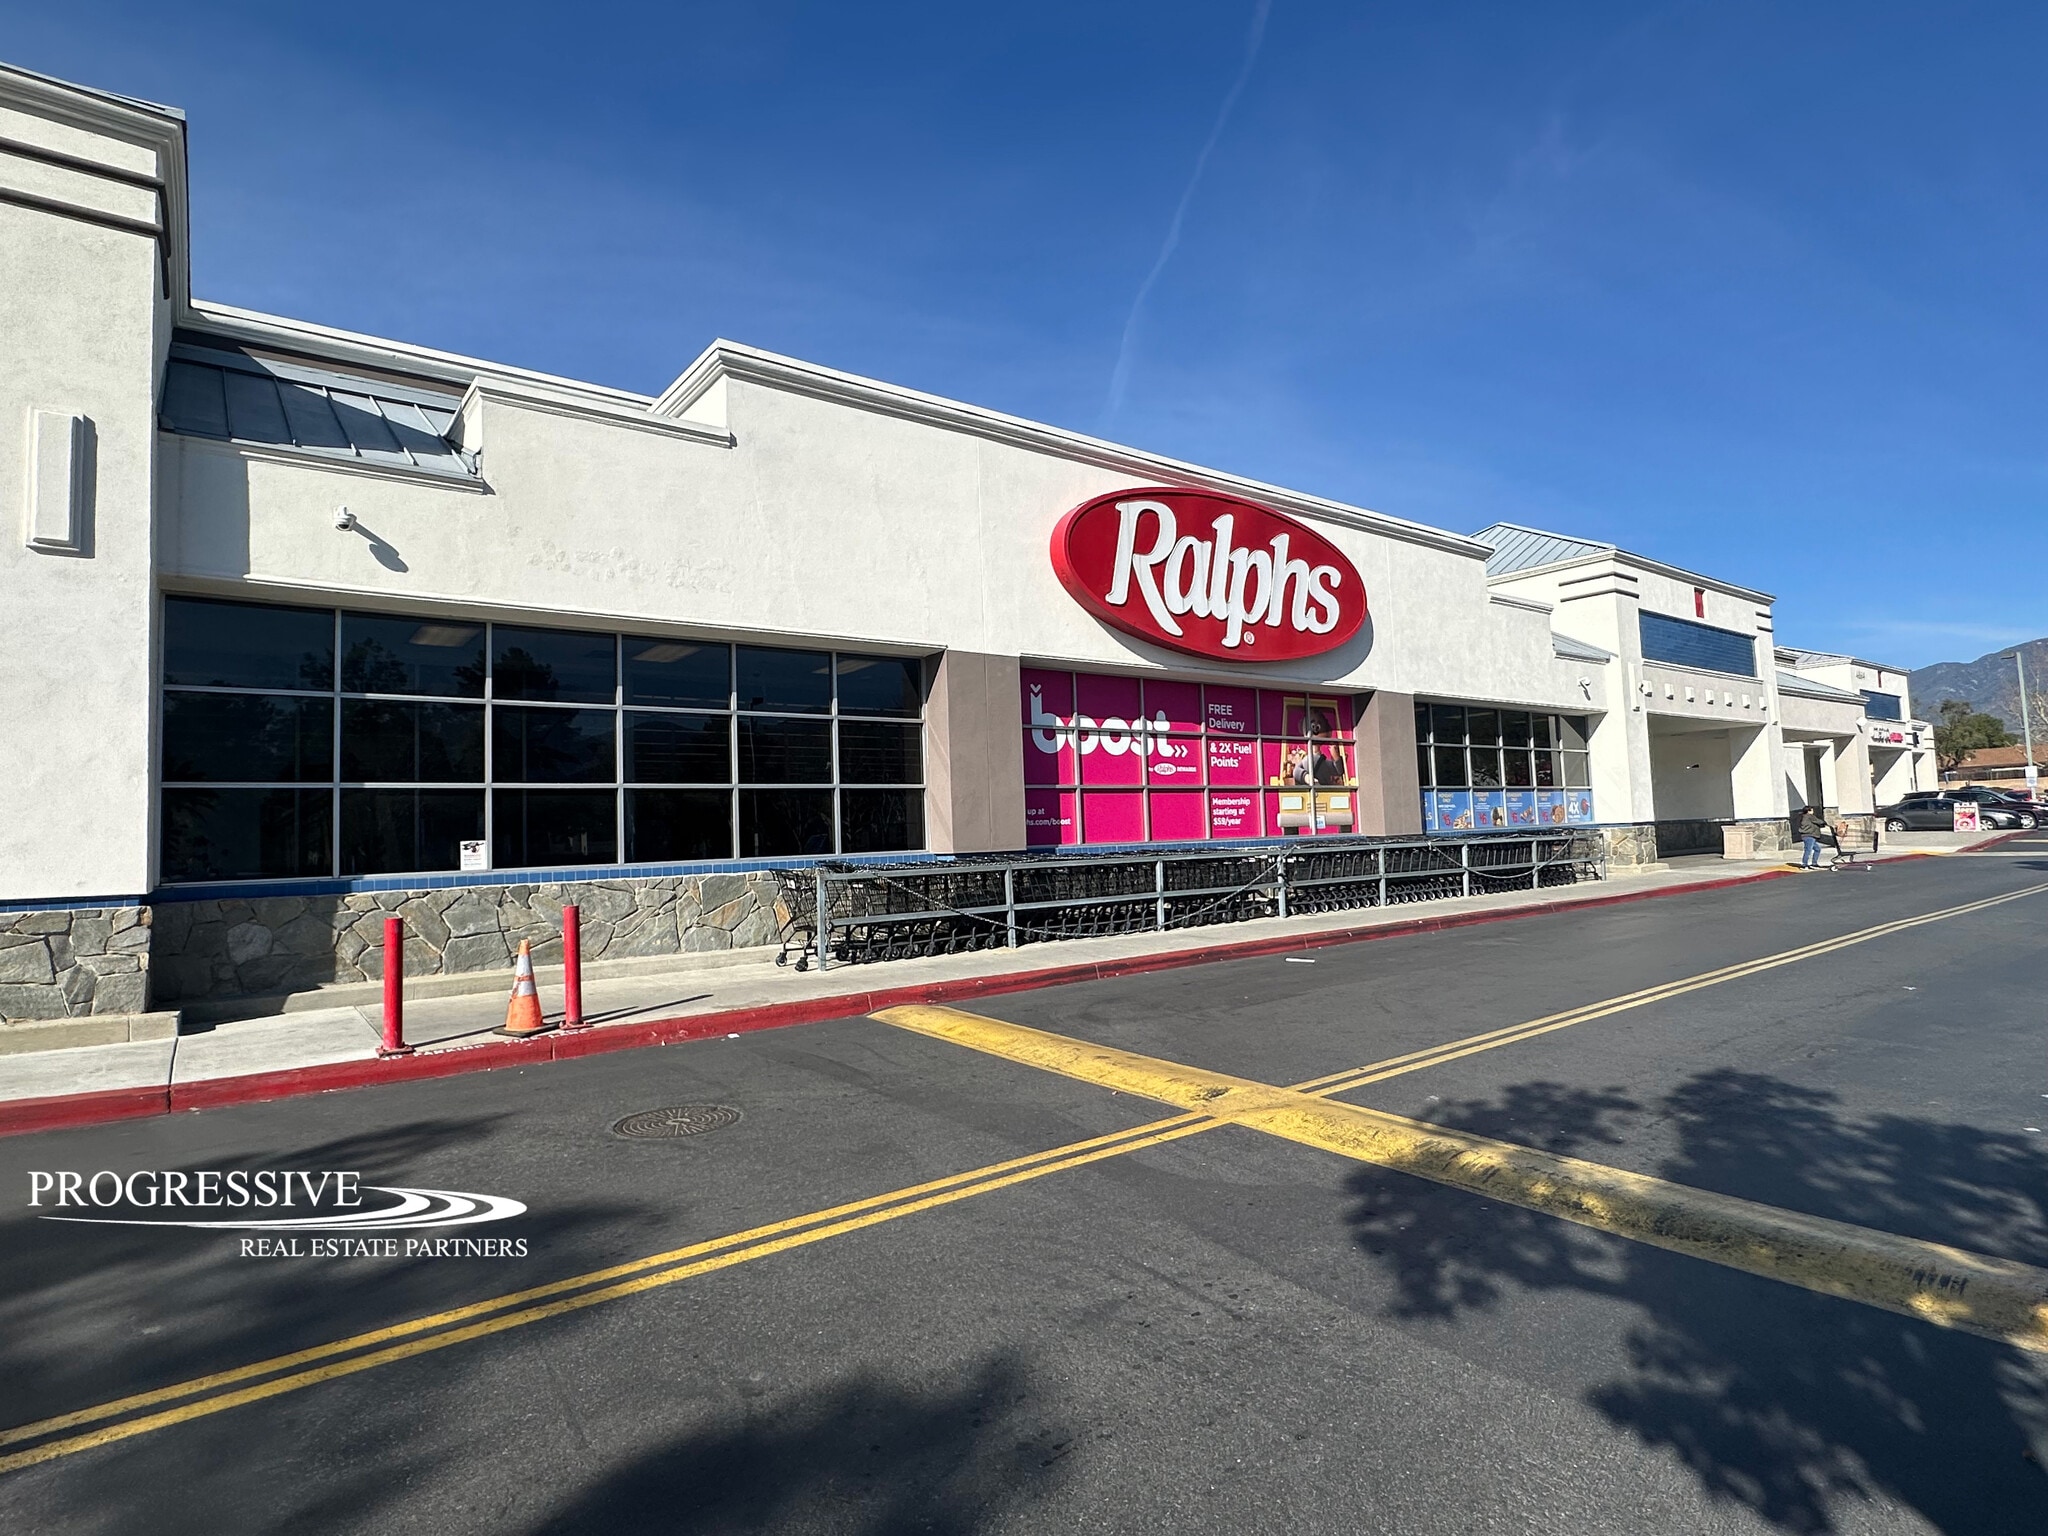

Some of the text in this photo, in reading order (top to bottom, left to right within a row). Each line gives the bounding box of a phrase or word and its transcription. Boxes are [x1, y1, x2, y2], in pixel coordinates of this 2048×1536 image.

[1105, 500, 1342, 648] Ralphs
[1208, 703, 1233, 716] FREE
[1030, 690, 1174, 757] boost
[1208, 717, 1245, 732] Delivery
[1210, 743, 1252, 755] & 2X Fuel
[1212, 797, 1251, 807] Membership
[1568, 801, 1580, 815] 4X
[1027, 808, 1037, 816] up
[1212, 807, 1237, 816] starting
